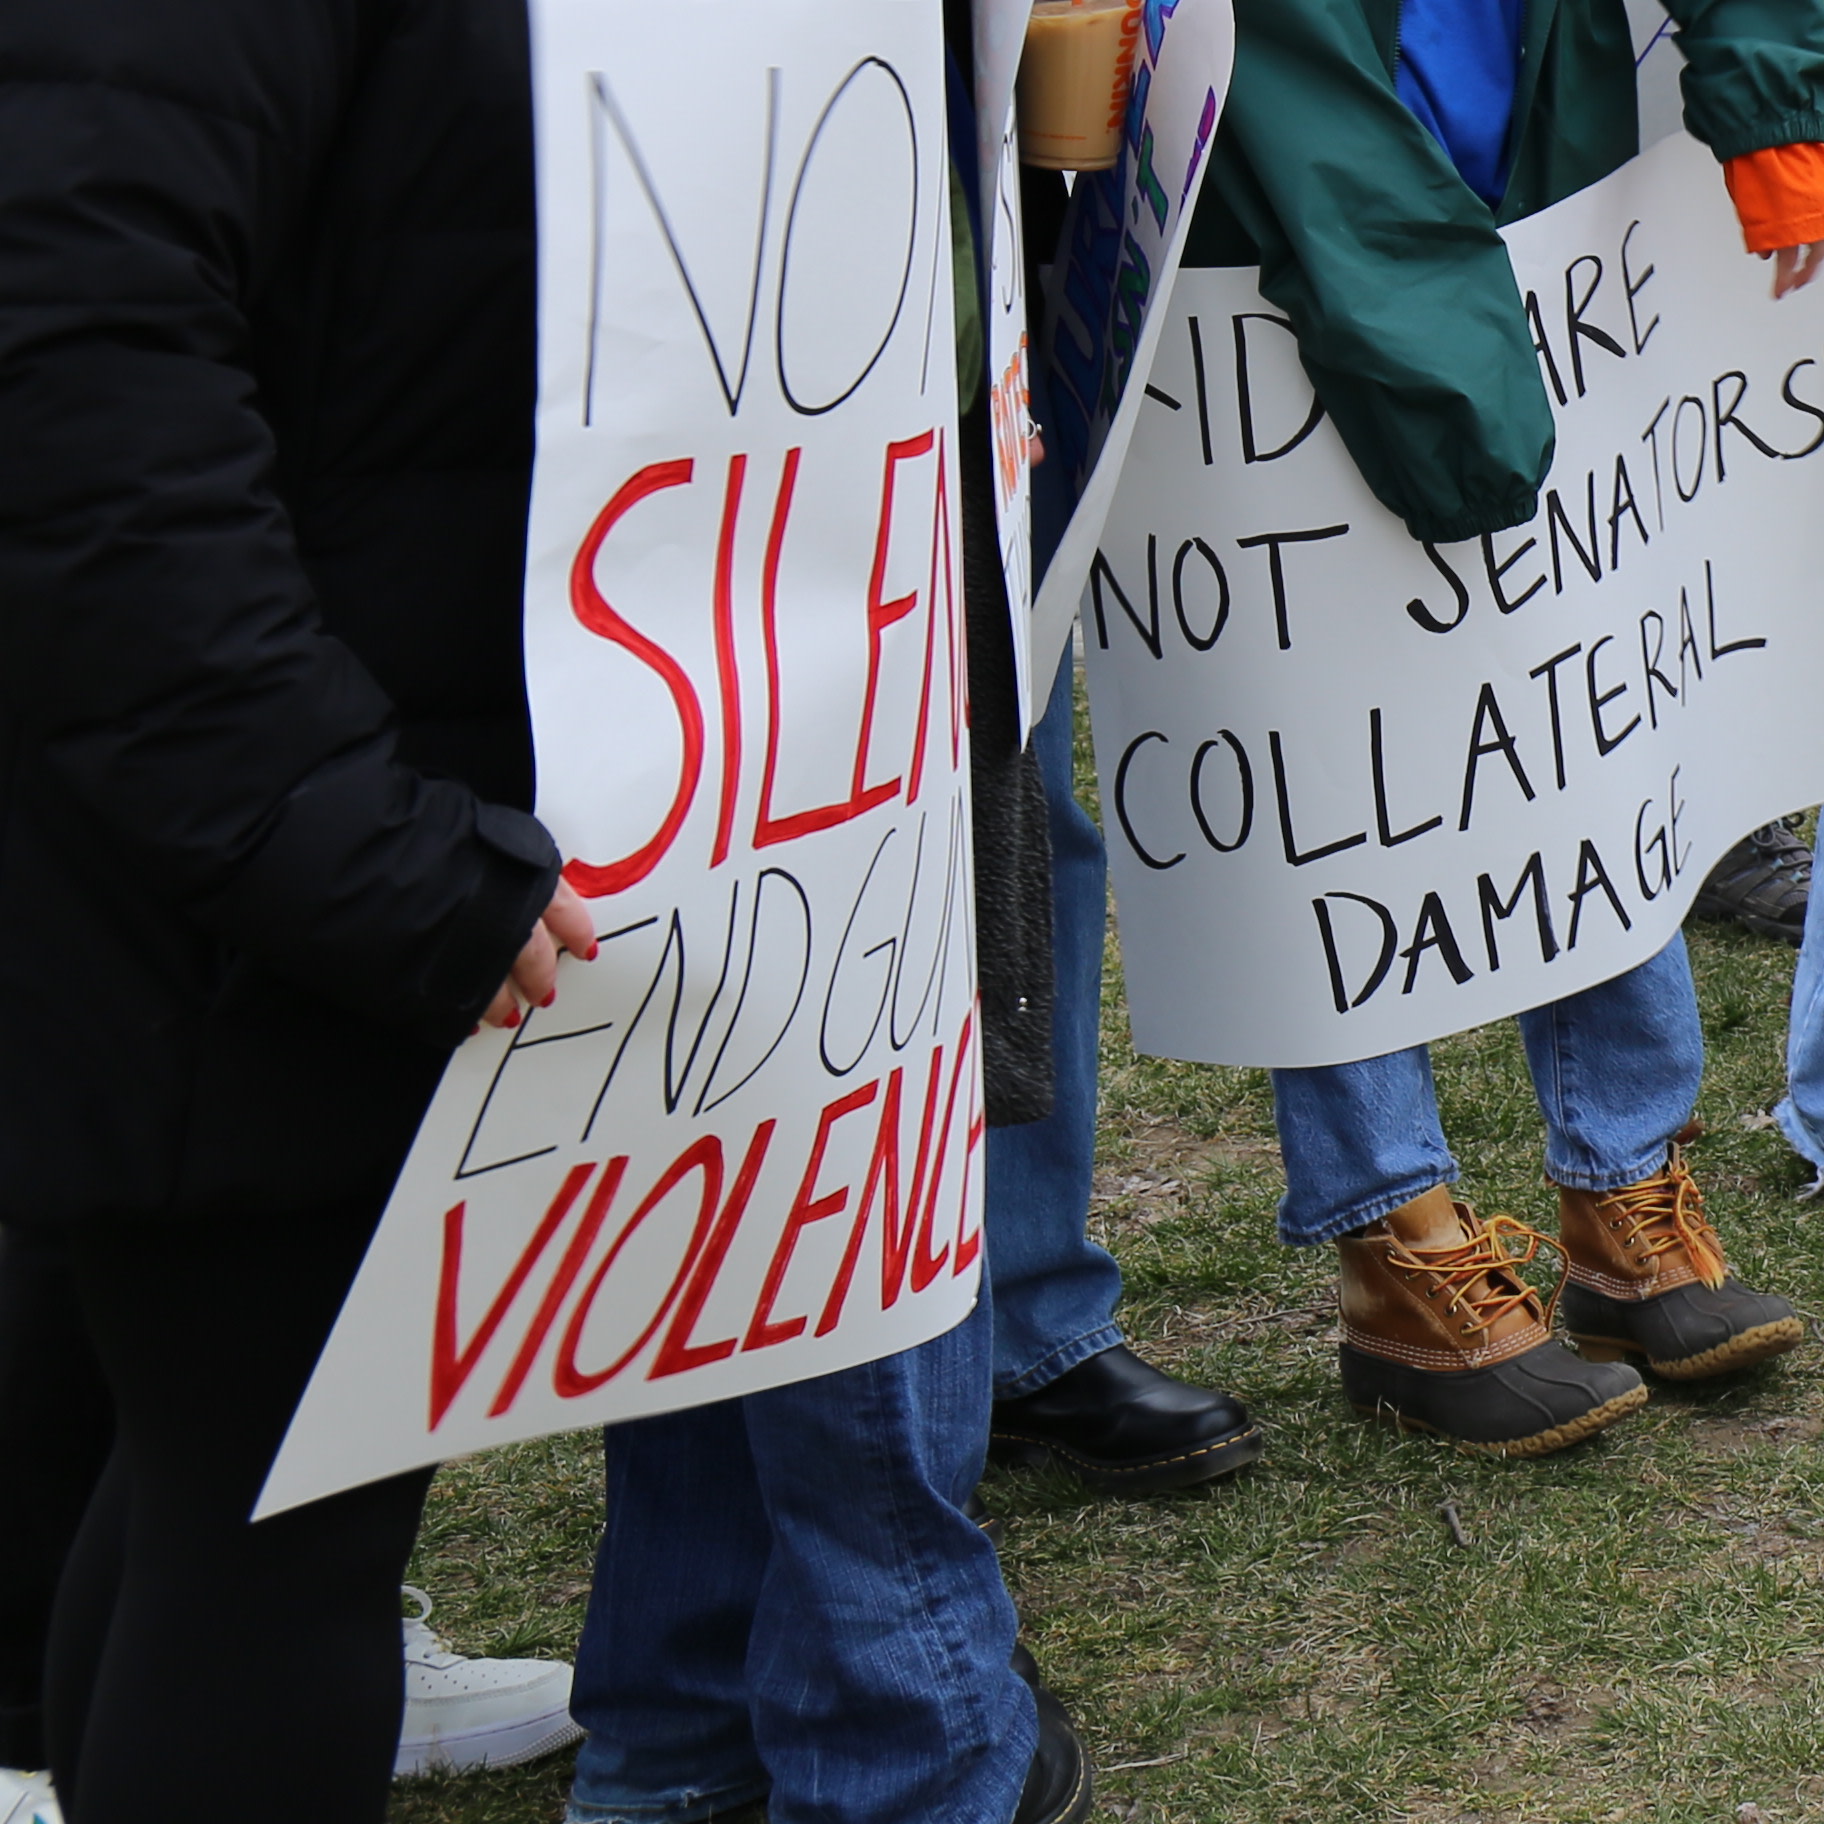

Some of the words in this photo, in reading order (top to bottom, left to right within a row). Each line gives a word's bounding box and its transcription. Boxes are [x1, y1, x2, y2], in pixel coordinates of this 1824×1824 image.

[584, 56, 919, 428] NO
[569, 426, 970, 899] SILEN
[1090, 523, 1350, 660] NOT
[1113, 559, 1768, 871] COLLATERAL
[454, 866, 812, 1181] END
[1312, 764, 1693, 1015] DAMAGE
